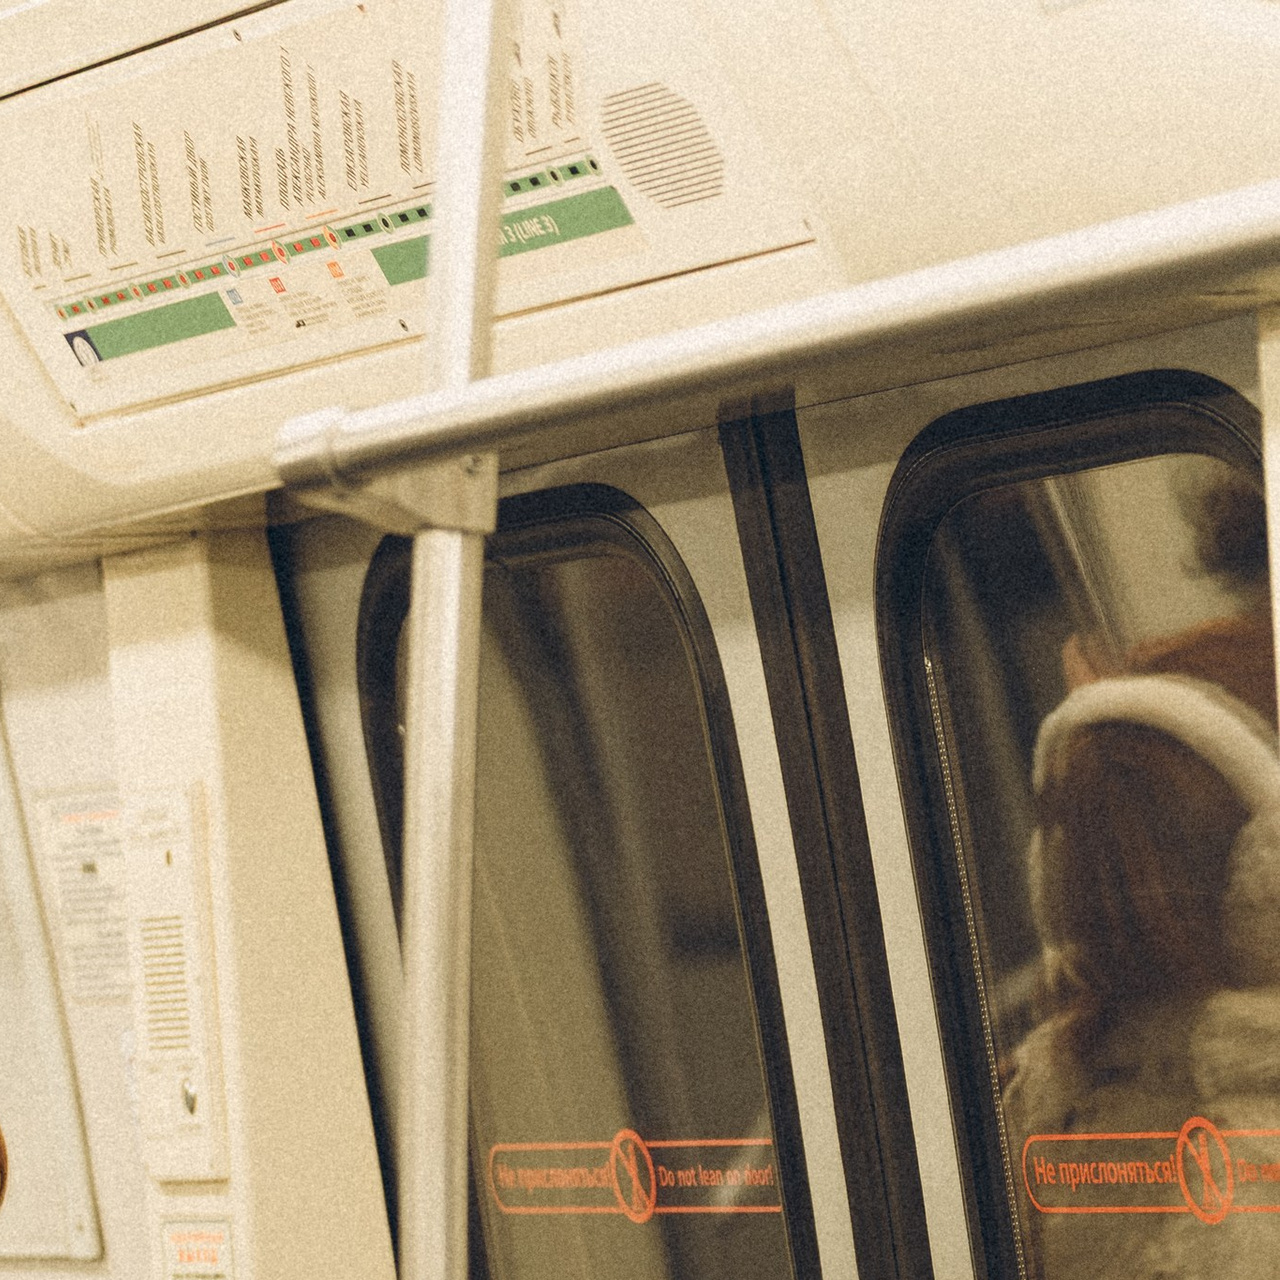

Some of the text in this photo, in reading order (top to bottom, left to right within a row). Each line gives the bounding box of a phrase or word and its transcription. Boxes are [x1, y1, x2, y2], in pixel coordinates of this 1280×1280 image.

[280, 55, 296, 123] НЕВСКОГО
[392, 59, 413, 176] ЛОМОНОСОВСКАЯ
[406, 71, 423, 173] LOMONOSOVSKAYA
[183, 129, 204, 235] ГОСТИНЫЙ ДВОР
[236, 134, 254, 222] МАЯКОВСКАЯ
[248, 135, 265, 219] MAYAKOVSKAYA
[275, 148, 291, 212] ПЛОЩАДЬ
[287, 122, 304, 207] АЛЕКСАНДРА
[339, 89, 358, 192] ЕЛИЗАРОВСКАЯ
[353, 99, 370, 189] YELIZAROVSKAYA
[90, 176, 108, 258] ПРИМОРСКАЯ
[132, 121, 156, 247] ВАСИЛЕОСТРОВСКАЯ
[202, 186, 215, 232] GOSTINY
[504, 225, 517, 243] 3
[513, 217, 546, 244] (LINE
[541, 214, 561, 236] 3)
[658, 1165, 675, 1187] Do
[677, 1167, 698, 1187] not
[698, 1163, 724, 1187] lean
[1033, 1154, 1179, 1193] Не прислоняться!
